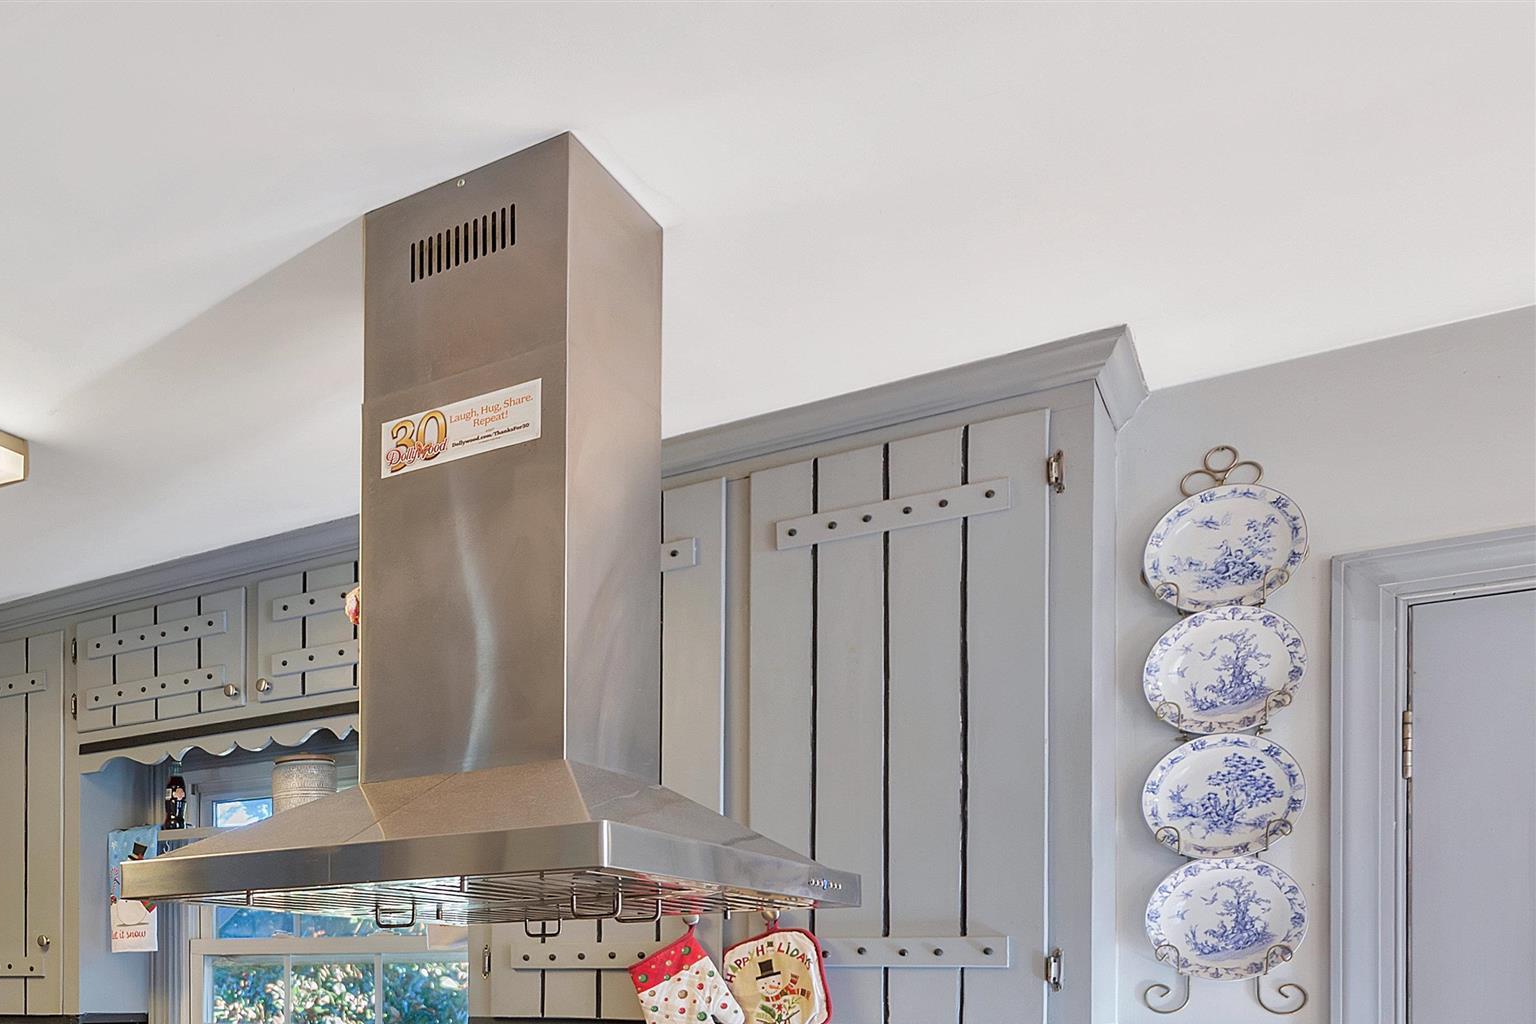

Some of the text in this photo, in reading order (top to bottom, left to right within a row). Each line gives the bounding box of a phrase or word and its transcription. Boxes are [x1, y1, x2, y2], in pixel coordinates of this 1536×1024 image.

[449, 394, 533, 424] Laugh, Hug, Share.
[472, 410, 509, 427] Repeat!
[390, 410, 448, 473] 30
